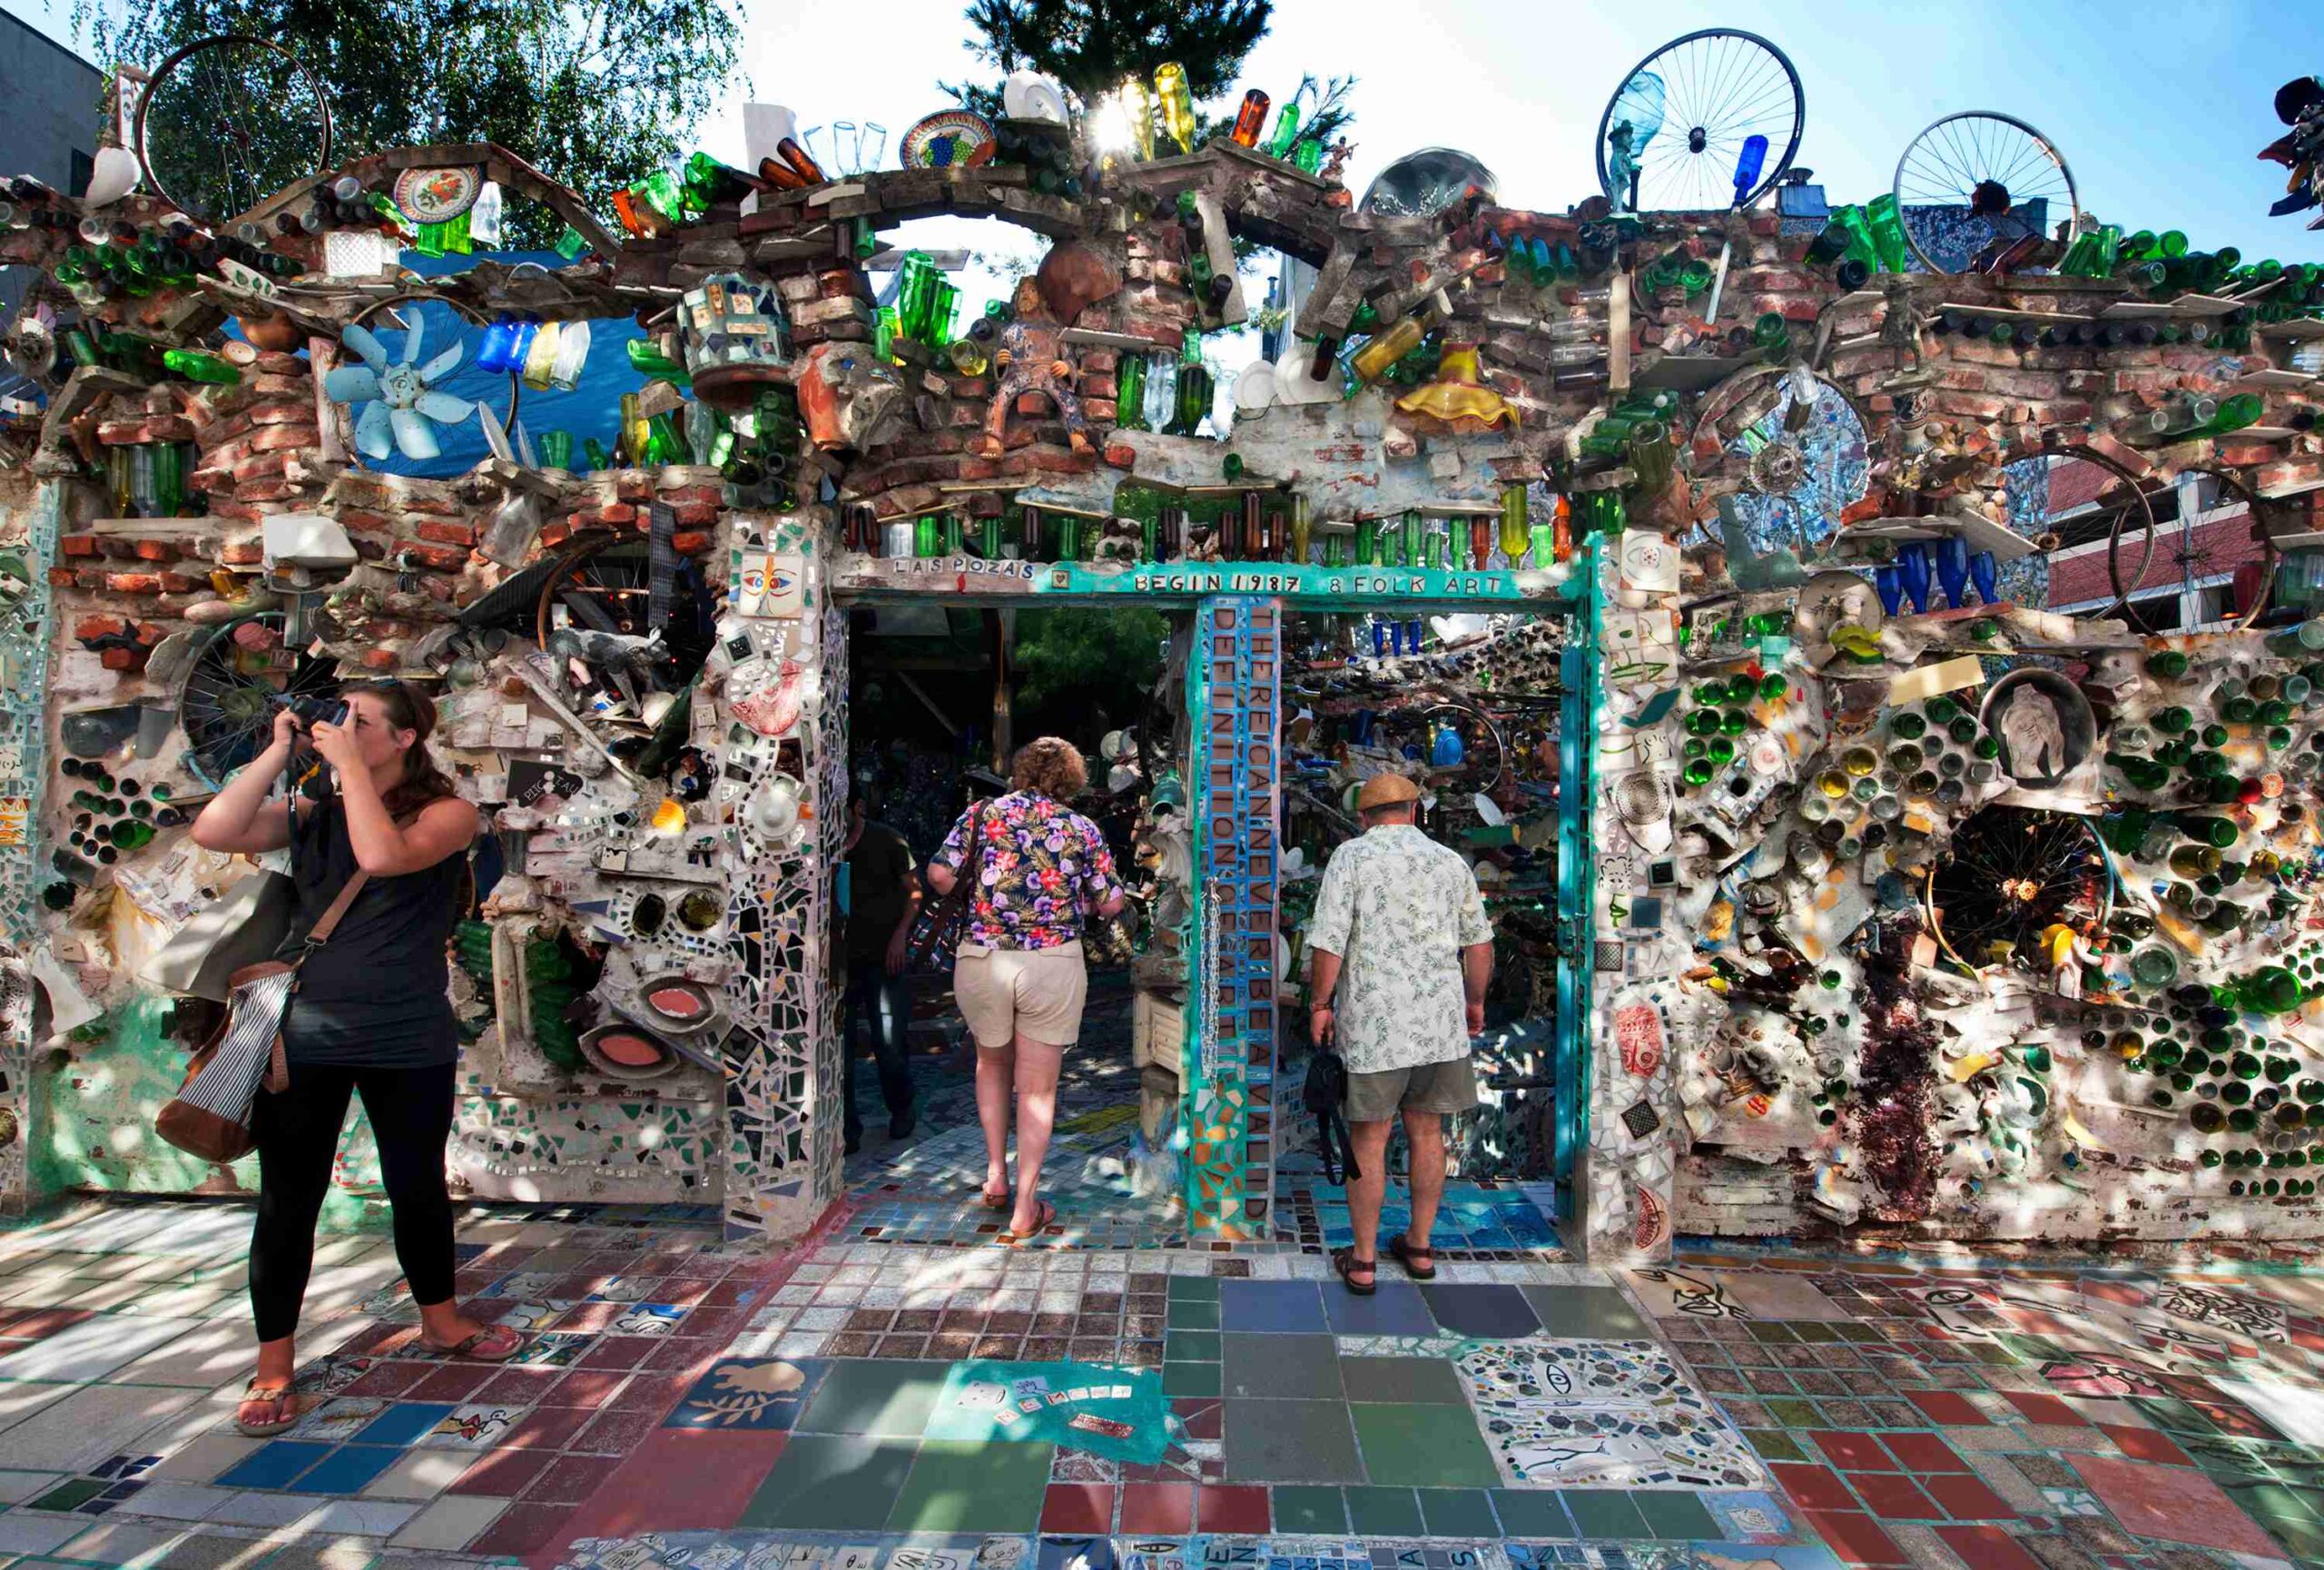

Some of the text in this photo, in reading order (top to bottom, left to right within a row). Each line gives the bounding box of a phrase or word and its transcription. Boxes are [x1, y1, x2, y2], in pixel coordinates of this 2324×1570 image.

[895, 558, 1034, 578] LAS POZAS
[1135, 575, 1221, 591] BEGIN
[1236, 575, 1299, 591] 1987
[1354, 576, 1425, 593] FOLK
[1444, 577, 1501, 595] ART
[1249, 607, 1273, 733] THERE
[1211, 607, 1236, 864] DEFINITION
[1248, 745, 1272, 816] CAN
[1249, 828, 1272, 958] NEVER
[1249, 978, 1272, 1030] BE
[1246, 1083, 1271, 1219] VALID
